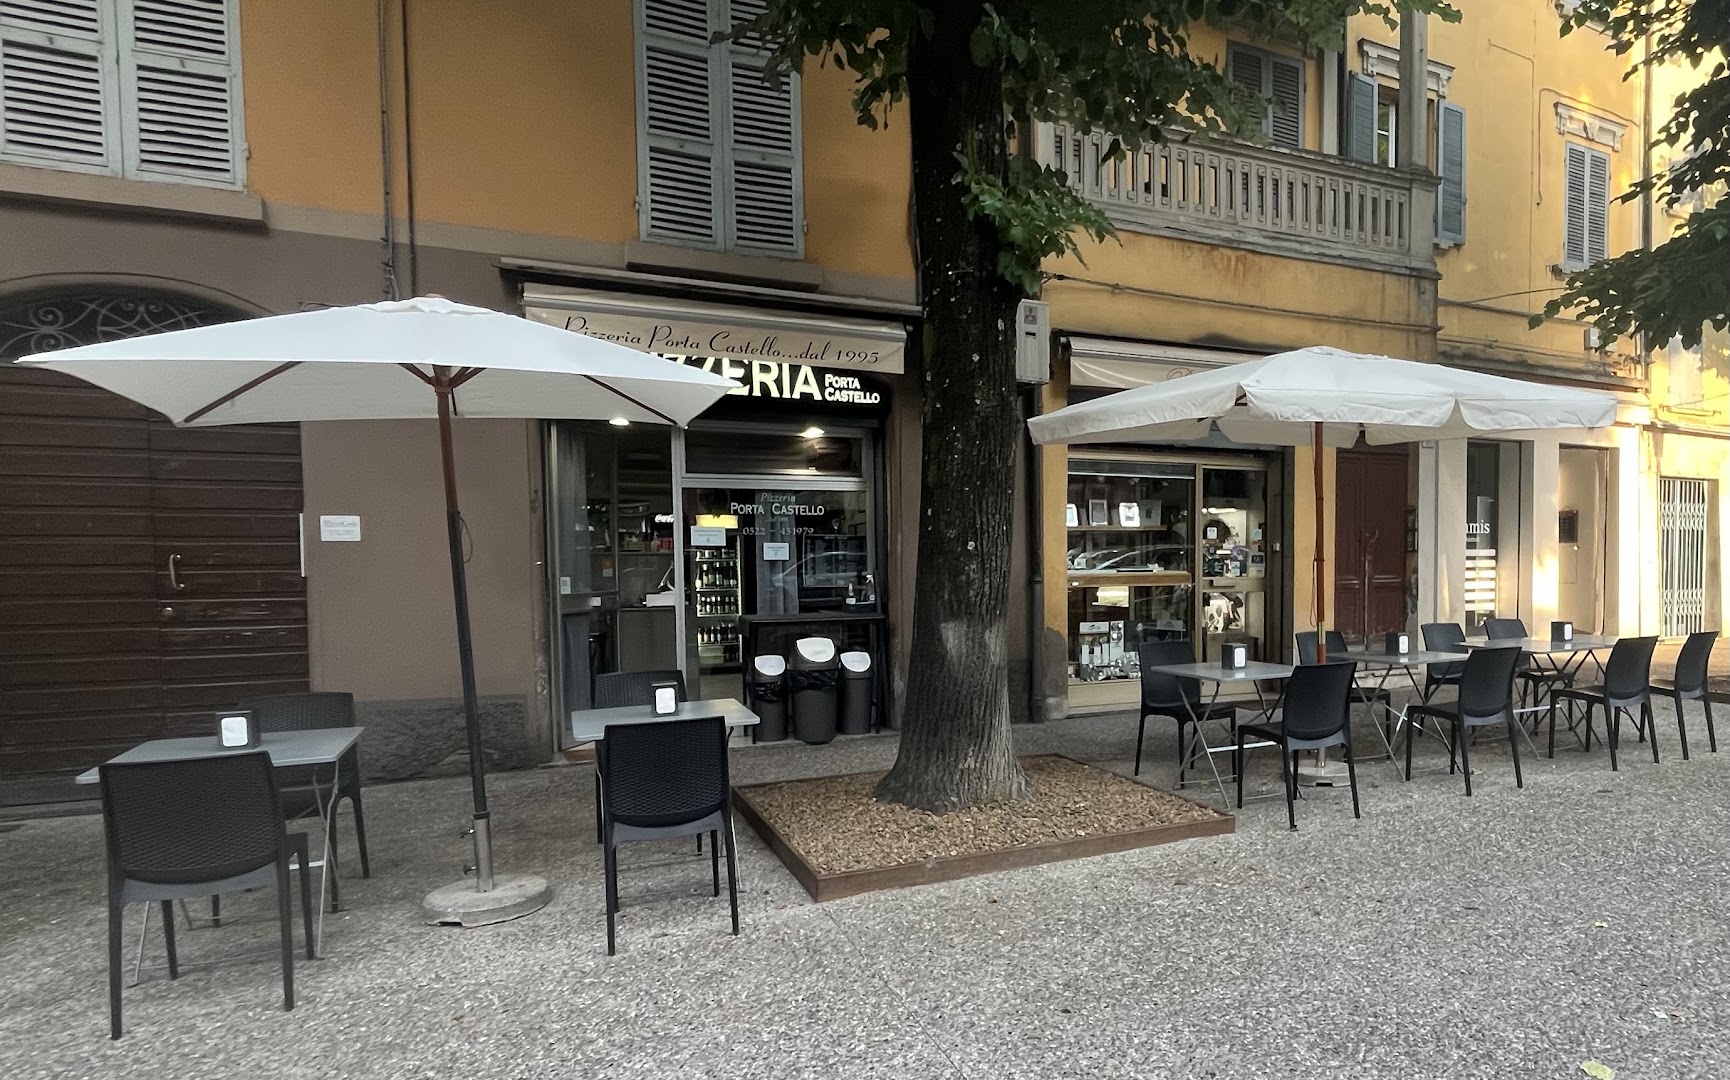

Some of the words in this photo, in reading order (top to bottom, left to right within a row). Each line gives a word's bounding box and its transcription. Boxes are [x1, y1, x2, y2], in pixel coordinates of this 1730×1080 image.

[648, 325, 701, 349] Porta
[836, 350, 879, 364] 1995
[650, 352, 823, 401] ERIA
[824, 374, 861, 389] PORTA
[824, 387, 881, 404] CASTELLO
[761, 492, 796, 502] Pizzeria
[730, 502, 765, 514] PORTA
[772, 503, 825, 516] CASTELLO
[743, 526, 766, 536] 0522
